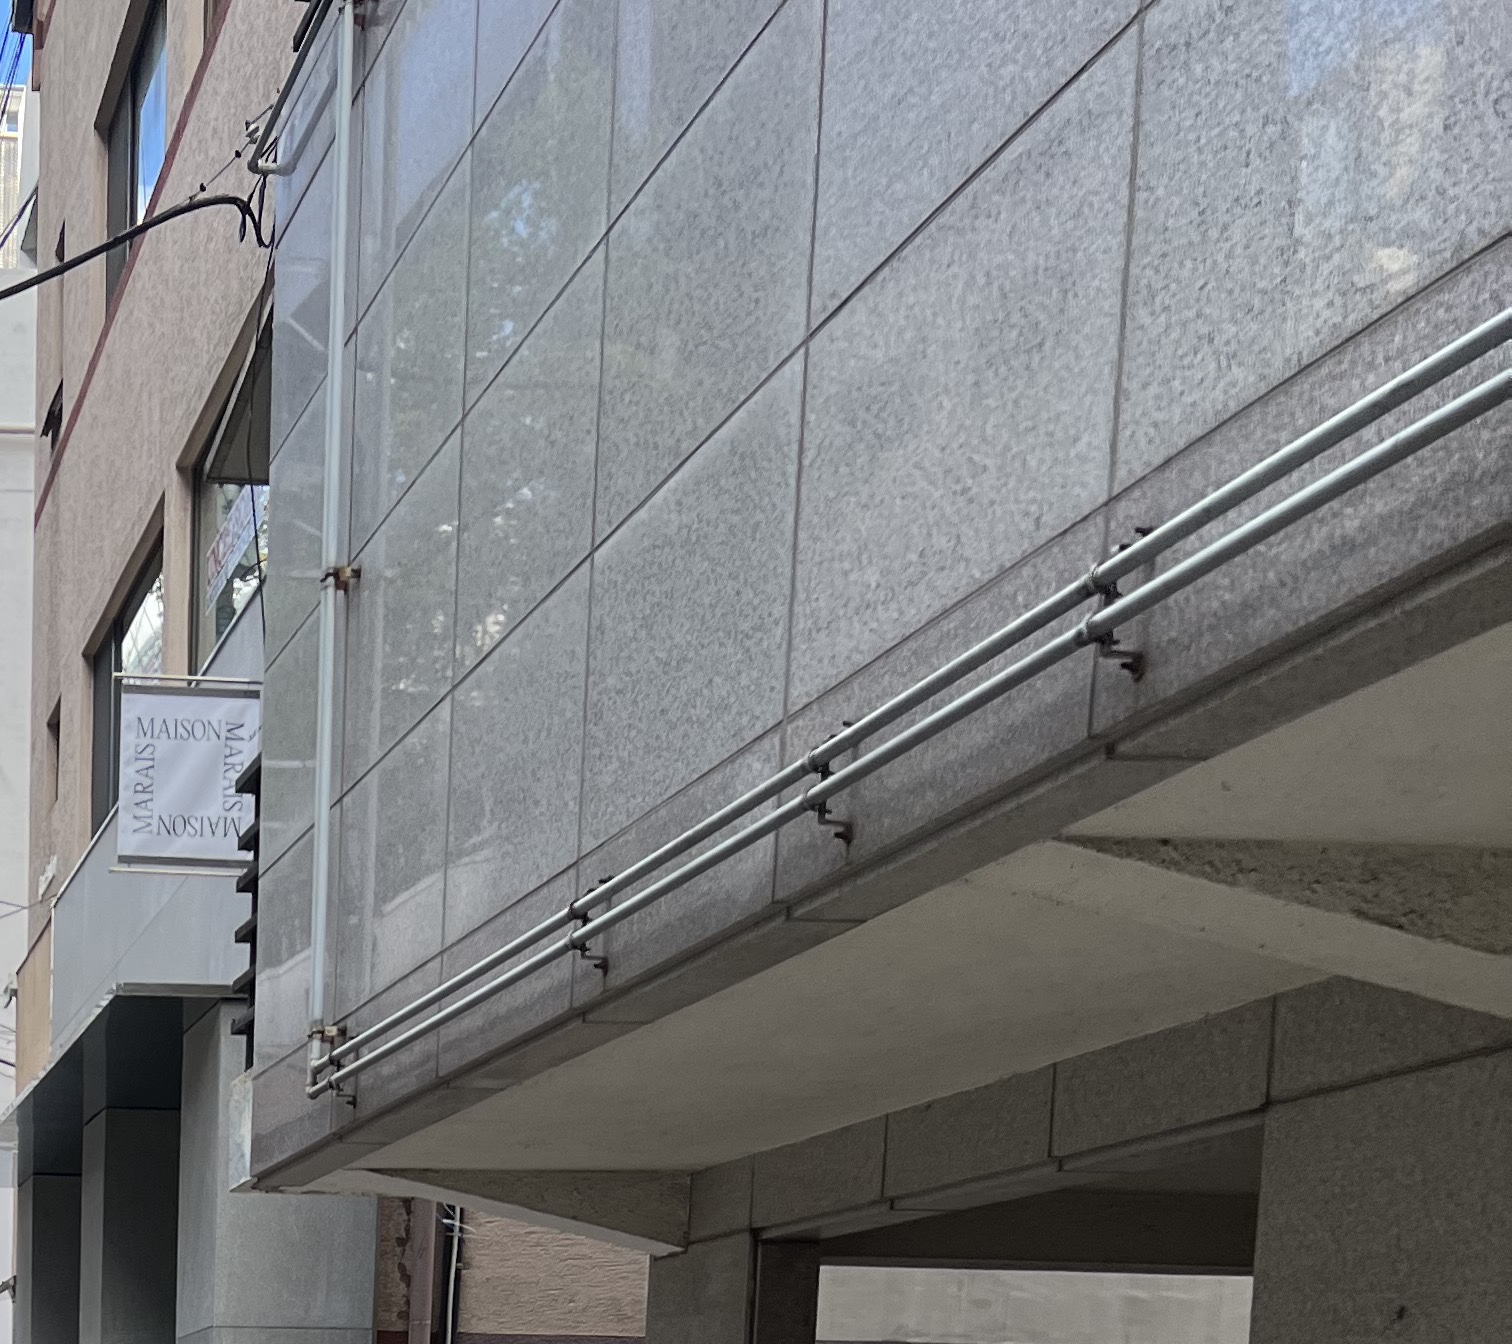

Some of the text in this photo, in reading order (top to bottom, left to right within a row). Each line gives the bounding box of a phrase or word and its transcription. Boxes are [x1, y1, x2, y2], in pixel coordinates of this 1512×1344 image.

[136, 716, 222, 741] MAISON
[133, 743, 156, 834] MARAIS
[223, 721, 245, 812] MARAIS
[157, 814, 242, 839] MAISON
